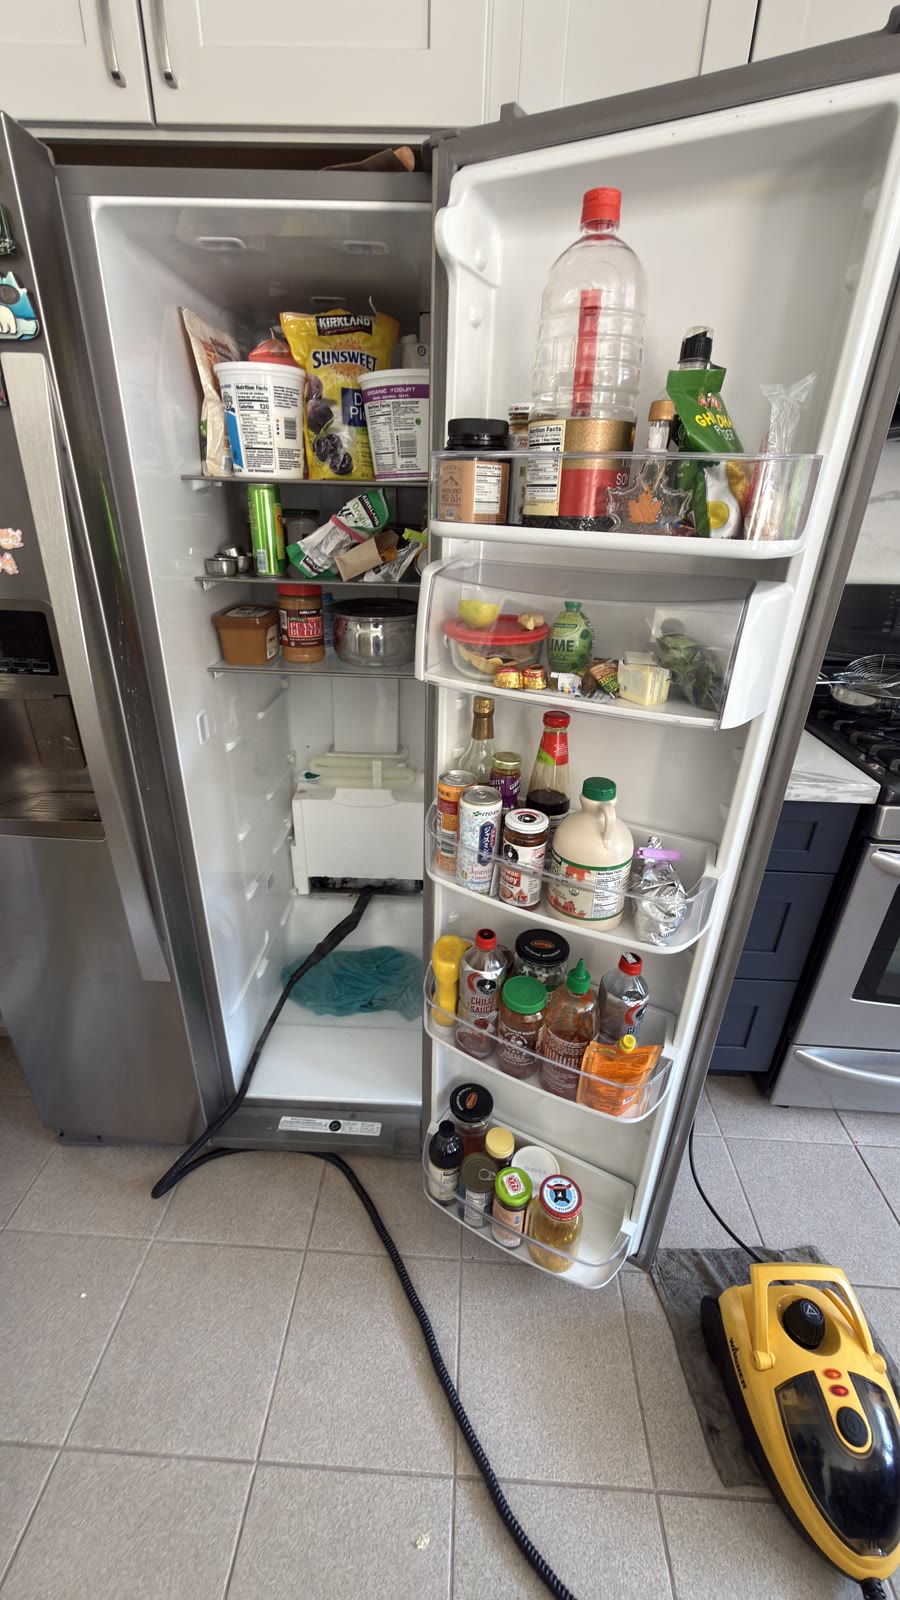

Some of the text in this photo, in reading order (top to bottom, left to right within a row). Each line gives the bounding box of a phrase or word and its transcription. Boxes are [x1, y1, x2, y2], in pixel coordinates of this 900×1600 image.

[319, 316, 370, 328] KIRKLAND
[312, 351, 378, 372] SUNSWEET
[616, 472, 628, 486] SO
[471, 996, 494, 1006] CHILLI
[470, 1006, 494, 1014] SAUCE
[730, 1336, 746, 1388] WAGNER
